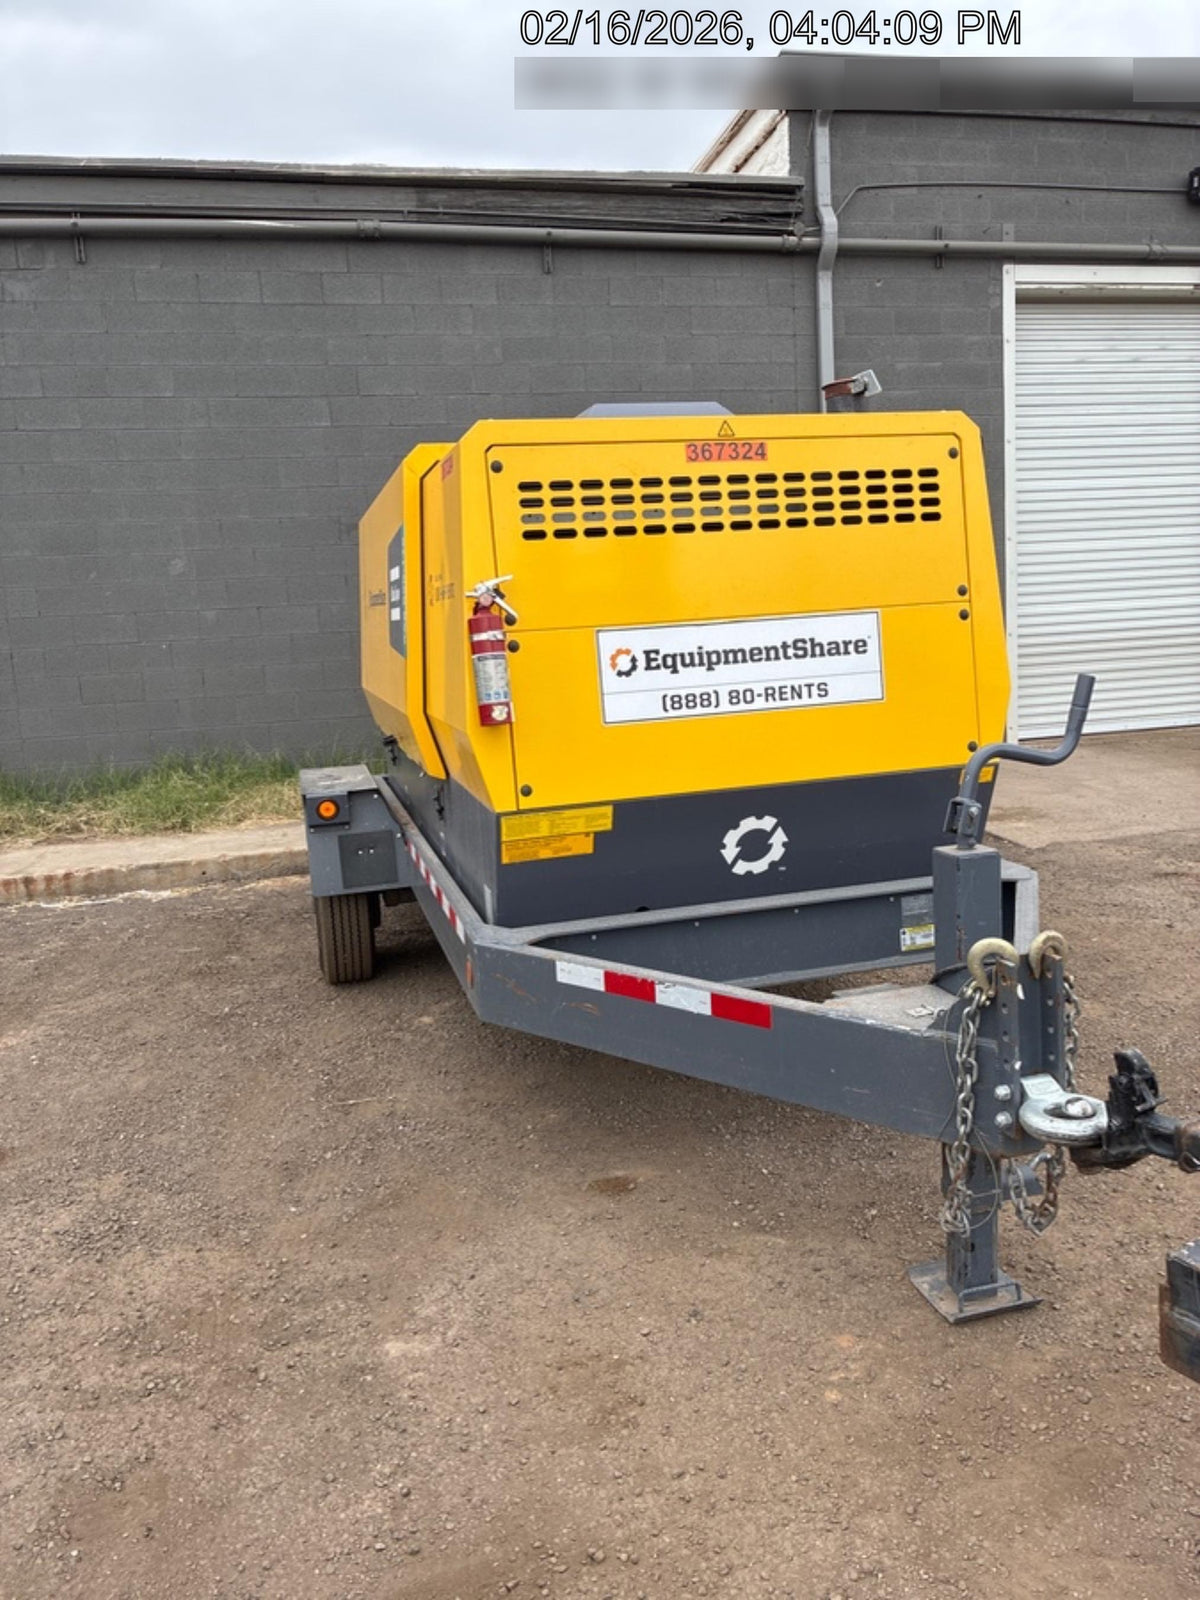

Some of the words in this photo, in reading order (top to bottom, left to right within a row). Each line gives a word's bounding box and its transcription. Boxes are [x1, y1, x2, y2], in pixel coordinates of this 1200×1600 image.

[687, 442, 767, 462] 367324
[642, 637, 869, 675] EquipmentShare
[661, 689, 720, 713] (888)
[728, 682, 830, 706] 80-RENTS
